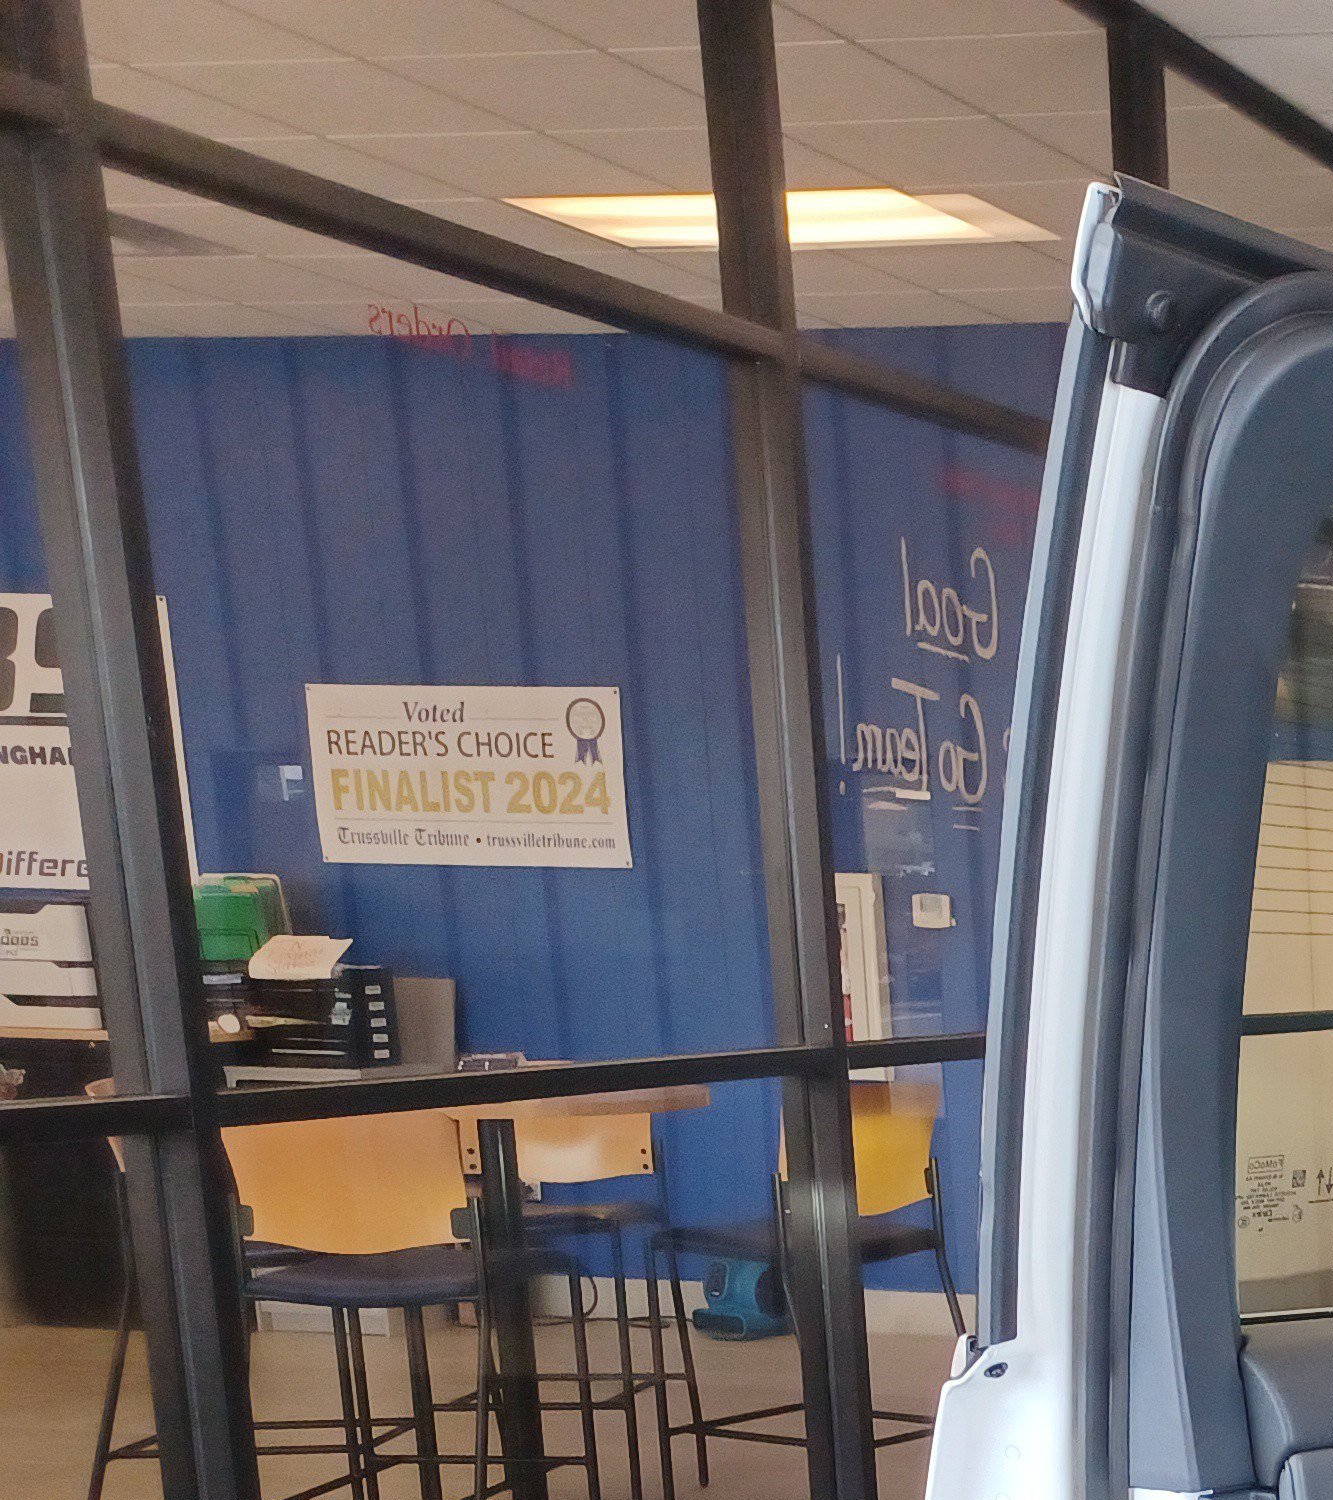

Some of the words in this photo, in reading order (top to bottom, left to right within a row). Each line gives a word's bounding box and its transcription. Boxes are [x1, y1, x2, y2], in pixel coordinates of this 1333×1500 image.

[402, 700, 466, 724] Voted
[0, 745, 74, 766] NGHA
[326, 729, 449, 757] READER'S
[456, 731, 555, 759] CHOICE
[330, 767, 497, 814] FINALIST
[504, 770, 612, 815] 2024
[337, 826, 410, 847] Trussville
[414, 827, 470, 847] Tribune
[486, 832, 616, 850] trussvilletribune.com
[0, 850, 89, 878] iffere
